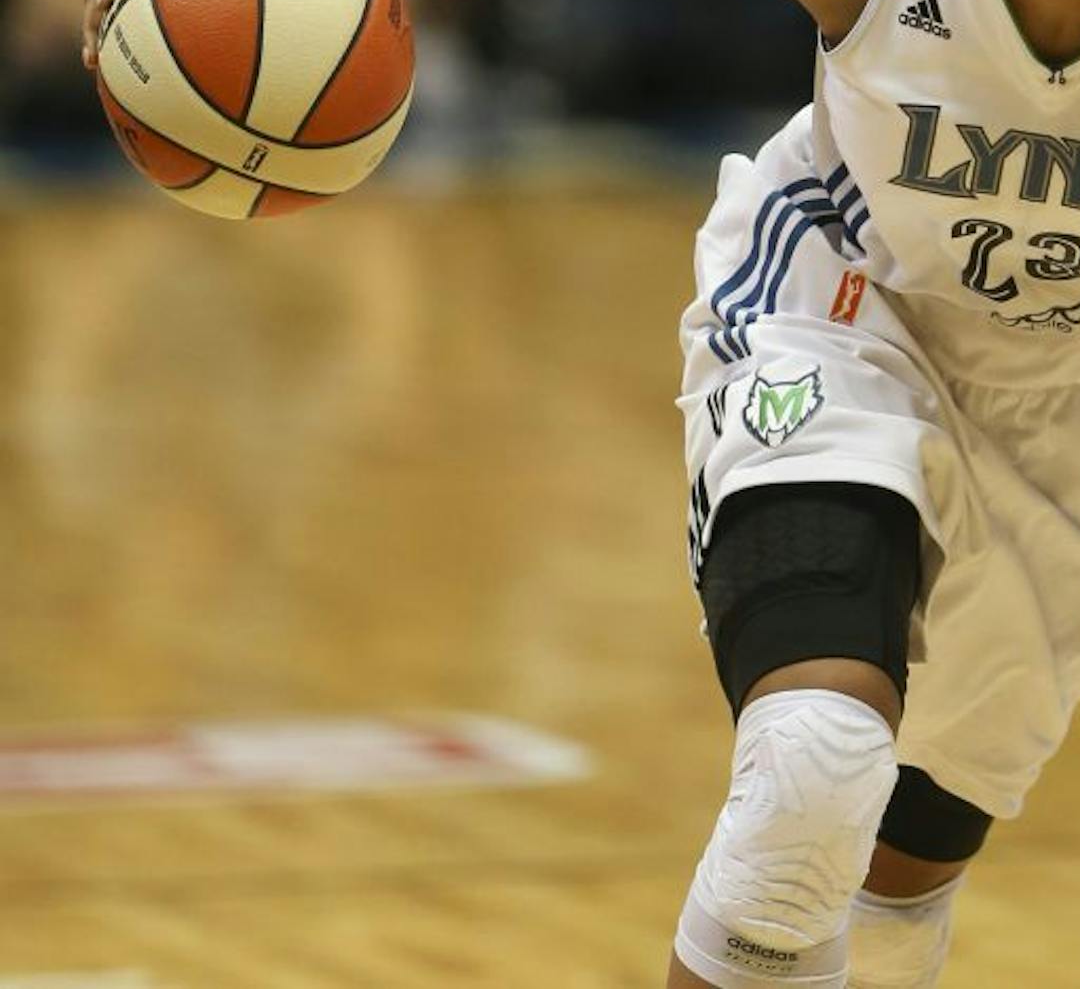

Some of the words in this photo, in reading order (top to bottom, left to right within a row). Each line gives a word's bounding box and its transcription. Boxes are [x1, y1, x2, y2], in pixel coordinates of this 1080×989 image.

[898, 10, 951, 40] adidas
[758, 383, 812, 432] M
[727, 936, 799, 962] adidas
